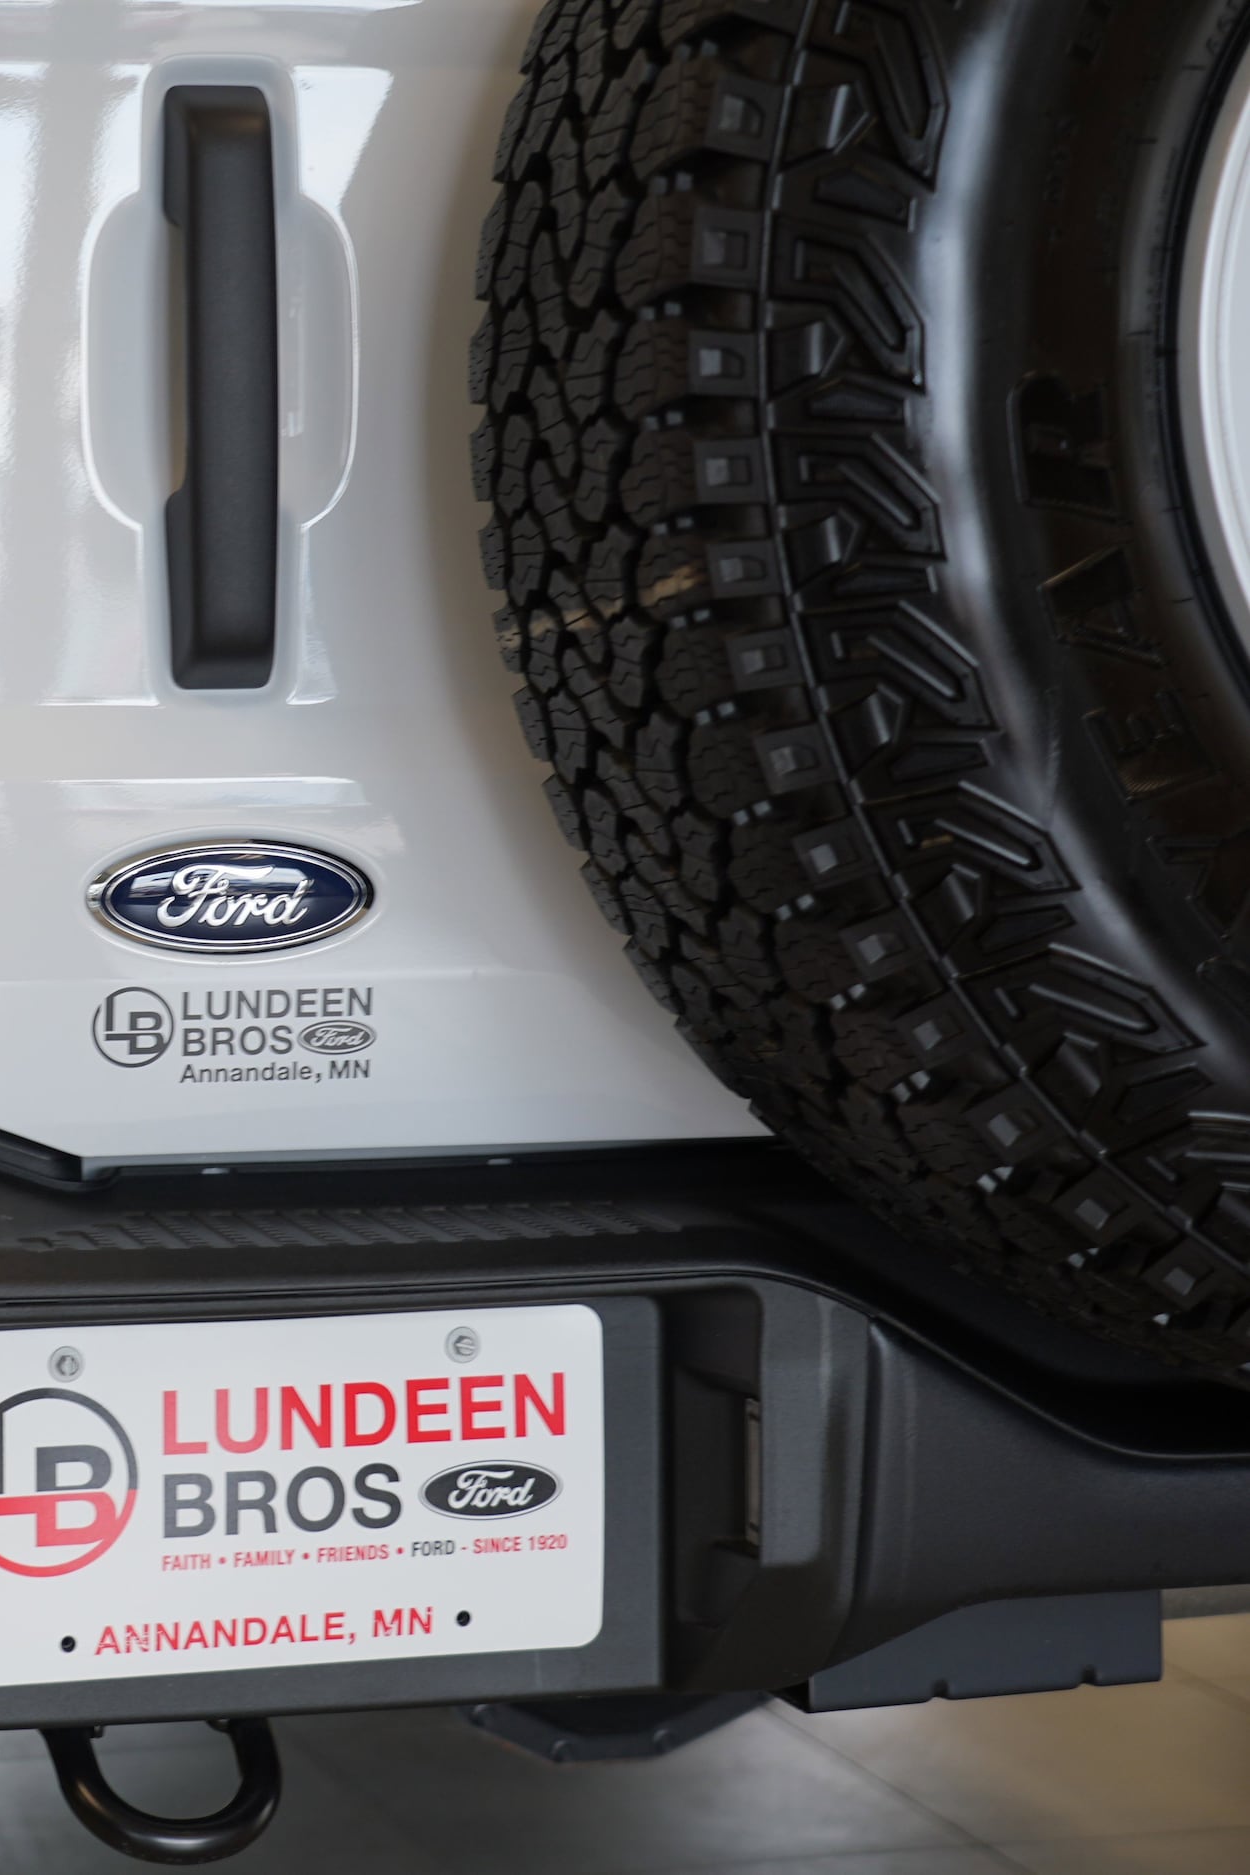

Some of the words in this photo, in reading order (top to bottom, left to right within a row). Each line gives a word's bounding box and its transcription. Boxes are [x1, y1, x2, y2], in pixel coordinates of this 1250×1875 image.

[156, 864, 314, 928] Ford
[181, 987, 373, 1021] LUNDEEN
[181, 1025, 293, 1057] BROS
[309, 1026, 365, 1047] Ford
[179, 1061, 322, 1084] Annandale,
[328, 1059, 370, 1080] MN
[162, 1371, 567, 1456] LUNDEEN
[163, 1463, 403, 1539] BROS
[447, 1469, 536, 1509] Ford
[162, 1553, 212, 1571] FAITH
[233, 1549, 296, 1568] FAMILY
[317, 1544, 390, 1563] FRIENDS
[411, 1540, 456, 1557] FORD
[473, 1536, 522, 1554] SINCE
[528, 1534, 568, 1551] 1920
[94, 1611, 356, 1656] ANNANDALE,
[372, 1606, 433, 1638] MN
